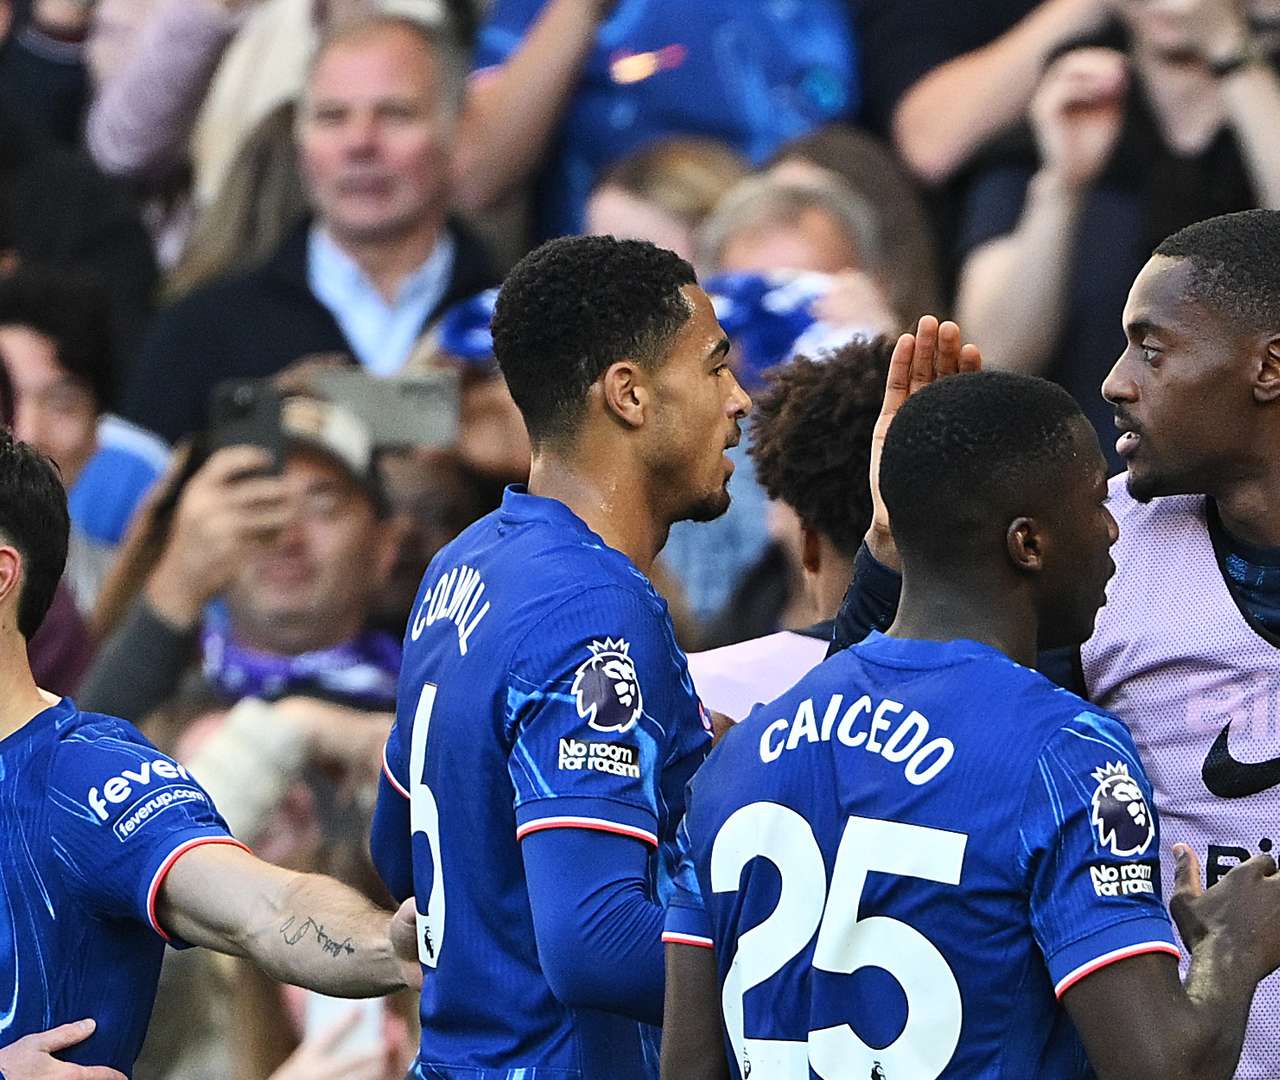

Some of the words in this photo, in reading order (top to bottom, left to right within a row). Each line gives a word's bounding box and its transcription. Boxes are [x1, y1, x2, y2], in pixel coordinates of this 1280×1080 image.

[559, 738, 587, 757] No
[589, 743, 633, 763] room
[759, 693, 955, 785] CAICEDO
[558, 754, 586, 771] for
[88, 759, 190, 821] fever
[119, 789, 205, 836] feverup.com
[1089, 864, 1119, 882] No
